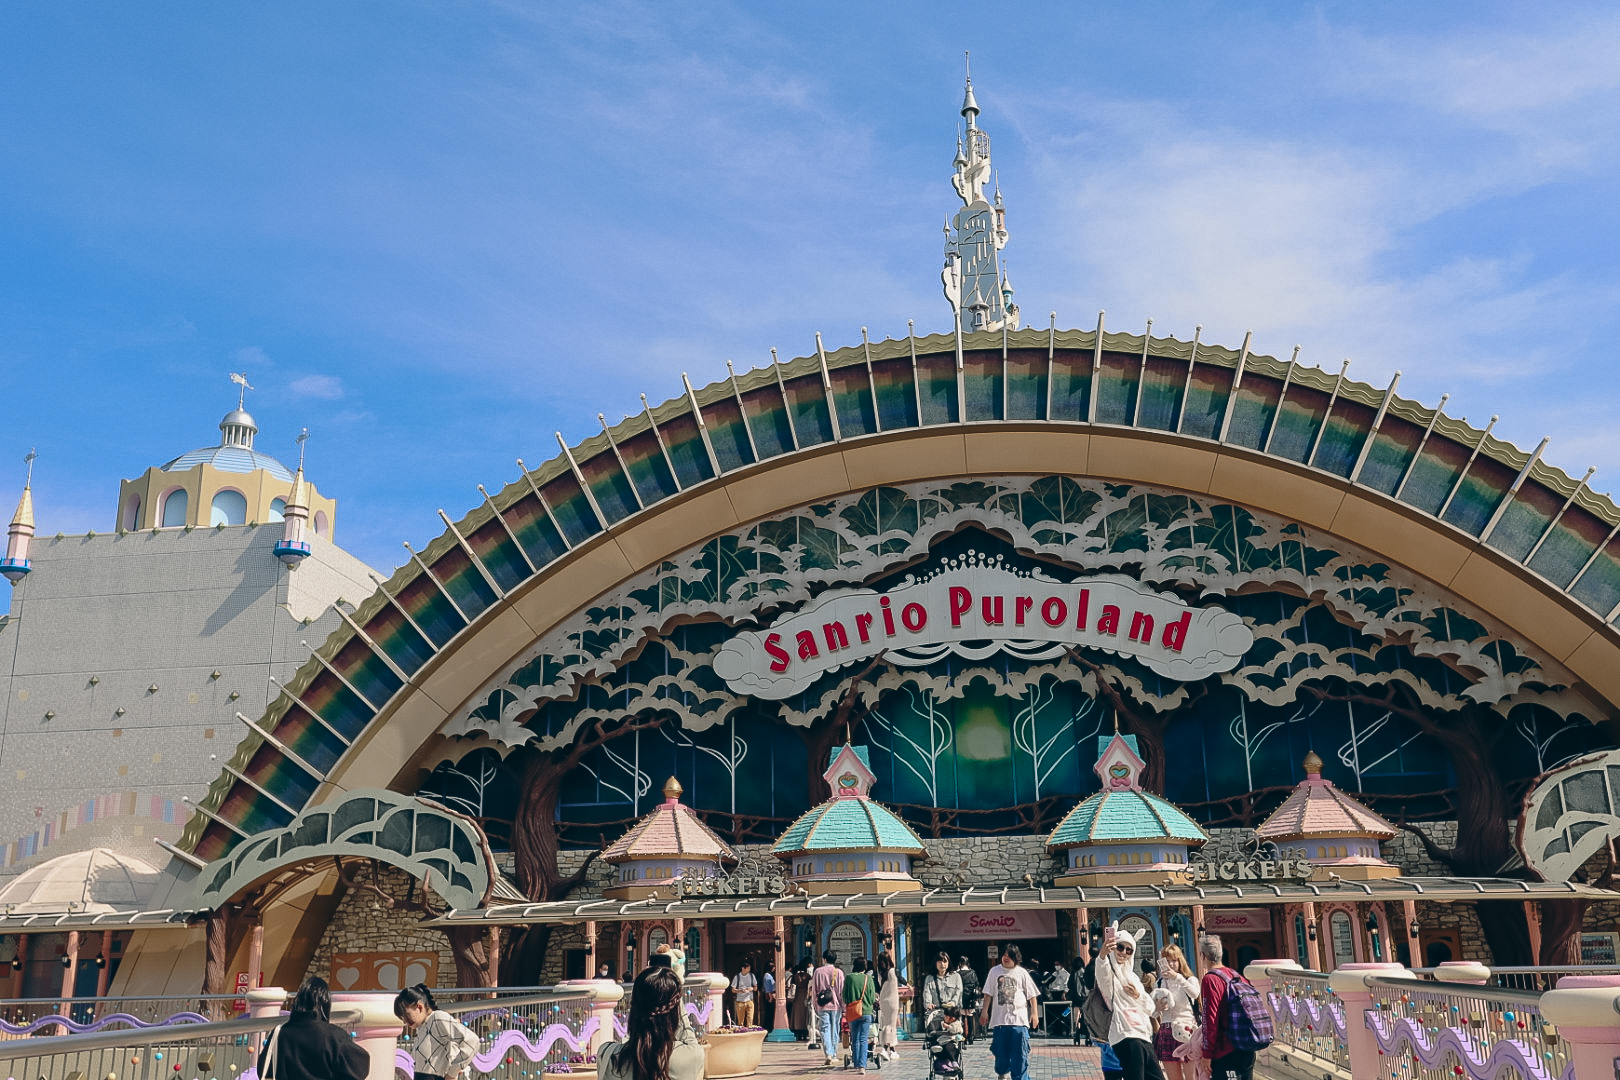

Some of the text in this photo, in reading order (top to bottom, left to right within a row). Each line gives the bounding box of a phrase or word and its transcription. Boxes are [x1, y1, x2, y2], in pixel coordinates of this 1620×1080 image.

[764, 586, 1192, 673] Sanrio Puroland
[1189, 859, 1312, 881] TICKETS
[674, 875, 786, 896] TICKETS
[969, 914, 1016, 928] Sanrio
